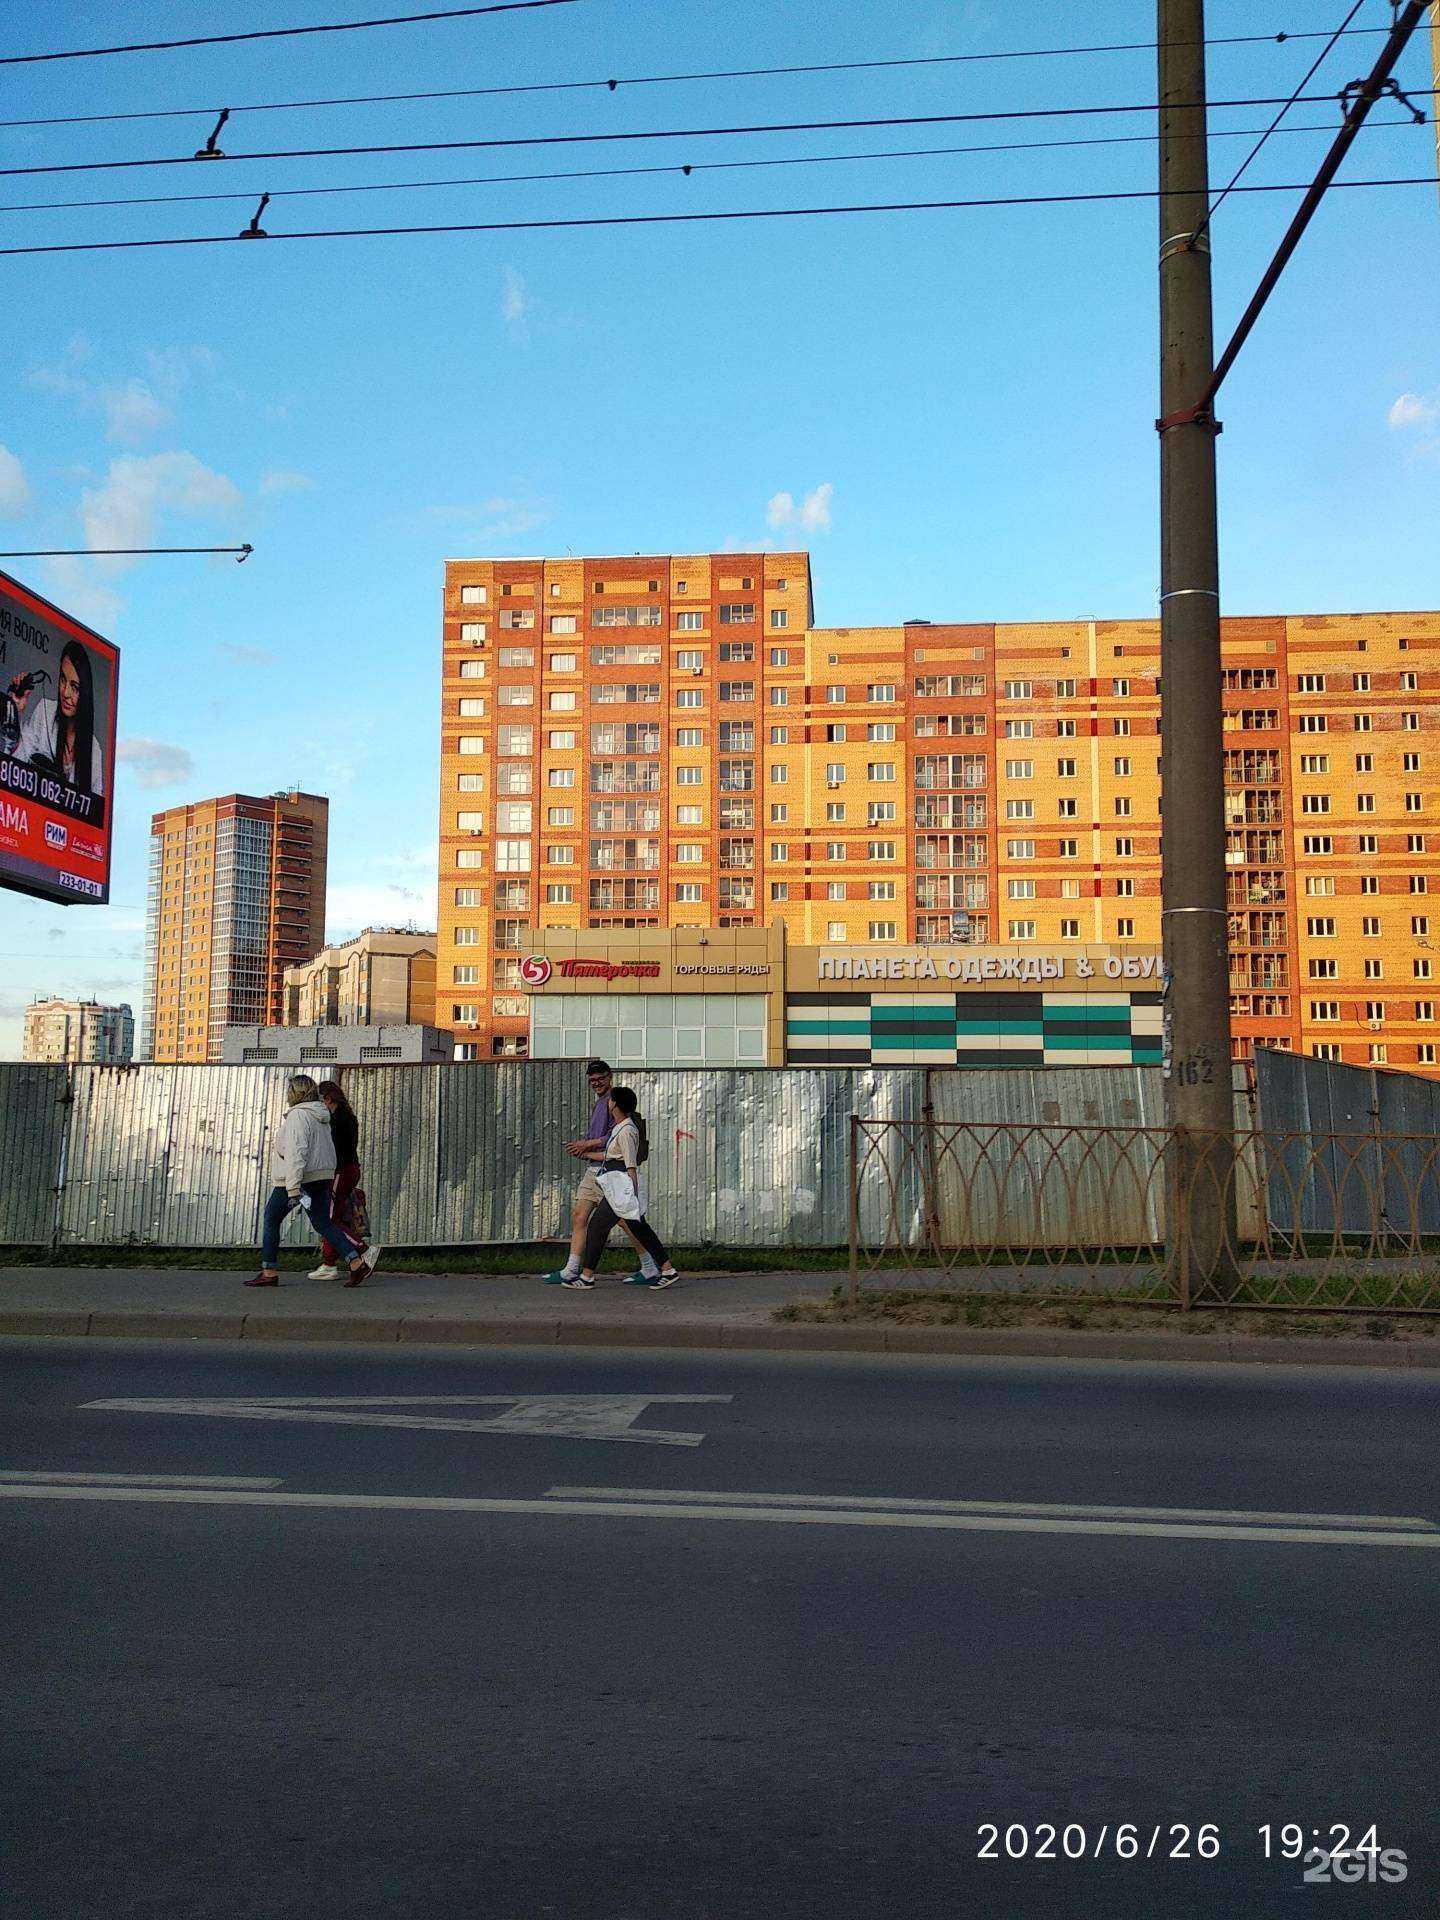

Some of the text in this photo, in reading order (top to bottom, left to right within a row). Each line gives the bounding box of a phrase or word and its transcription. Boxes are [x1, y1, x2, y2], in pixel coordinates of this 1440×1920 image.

[14, 617, 49, 654] ВОЛОС
[0, 761, 91, 816] 8(903) 062-77-77
[46, 823, 66, 845] РИМ
[61, 873, 98, 894] 233-01-01
[673, 964, 771, 977] ТОРГОВЫЕ РЯДЫ
[818, 957, 938, 980] ПЛАНЕТА
[944, 956, 1064, 984] ОДЕЖДЫ
[1075, 956, 1095, 979] &
